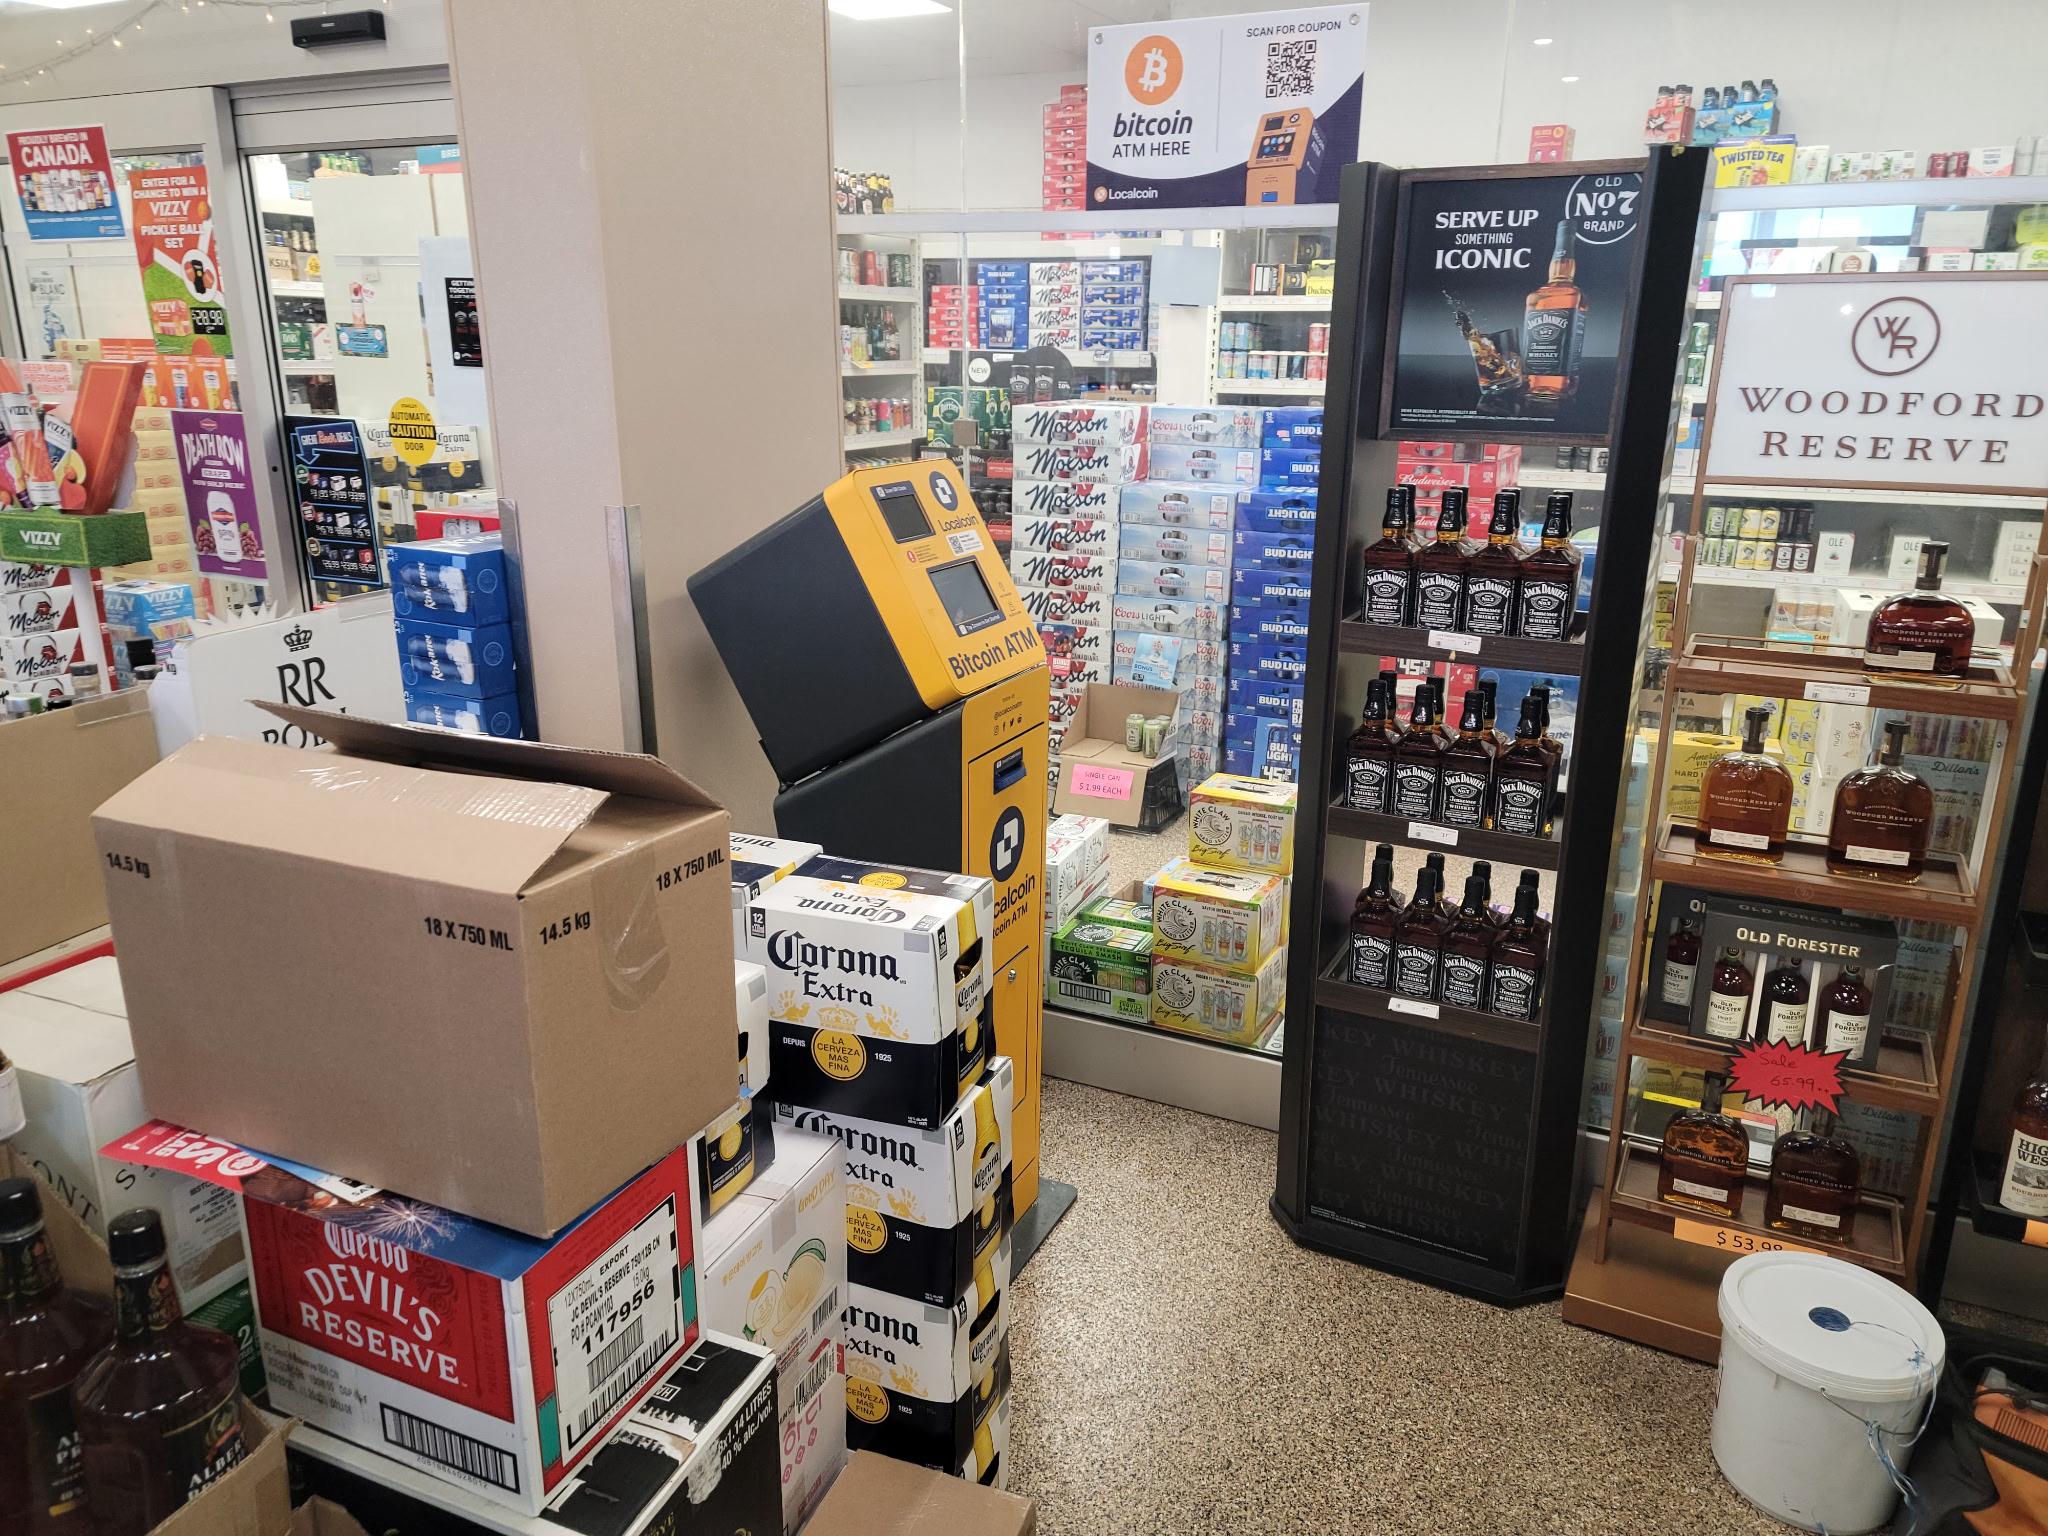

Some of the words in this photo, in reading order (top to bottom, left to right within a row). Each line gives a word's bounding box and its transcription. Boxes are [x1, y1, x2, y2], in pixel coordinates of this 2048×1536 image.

[1246, 27, 1274, 38] SCAN
[1275, 24, 1296, 36] FOR
[1298, 20, 1342, 34] COUPON
[1113, 109, 1193, 138] bitcoin
[21, 144, 93, 167] CANADA
[1112, 142, 1146, 159] ATM
[1150, 141, 1191, 157] HERE
[1720, 150, 1765, 165] TWISTED
[1766, 149, 1786, 164] TEA
[141, 177, 168, 187] ENTER
[170, 176, 187, 186] FOR
[188, 176, 196, 185] A
[1595, 176, 1623, 187] OLD
[133, 189, 168, 199] CHANCE
[169, 188, 179, 197] TO
[1108, 187, 1159, 200] Localcoin
[150, 200, 191, 216] VIZZY
[1435, 210, 1504, 229] SERVE
[1507, 209, 1539, 227] UP
[1583, 220, 1625, 233] BRAND
[141, 225, 176, 236] PICKLE
[1455, 232, 1513, 245] SOMETHING
[164, 237, 184, 248] SET
[1435, 248, 1532, 270] ICONIC
[1307, 286, 1331, 295] Duches
[971, 366, 987, 374] NEW
[1739, 387, 2044, 419] WOODFORD
[391, 412, 431, 423] AUTOMATIC
[1152, 419, 1179, 432] Coors
[1179, 420, 1205, 432] LIGHT
[390, 424, 434, 440] CAUTION
[1025, 410, 1109, 443] Molson
[436, 429, 470, 446] Corona
[181, 434, 215, 474] DEATH
[216, 433, 246, 475] ROW
[404, 441, 424, 452] DOOR
[1760, 431, 2009, 464] RESERVE
[1026, 448, 1109, 480] Molson
[203, 469, 229, 479] GRAPE
[1399, 474, 1456, 486] Budweiser
[1025, 484, 1106, 517] Molson
[937, 513, 980, 533] Localcoin
[20, 530, 62, 546] VIZZY
[1025, 520, 1106, 553] Molson
[1828, 536, 1843, 548] OLE
[418, 562, 437, 610] Kokanee
[1366, 575, 1382, 588] JACK
[1382, 572, 1407, 588] DANIEL'S
[1420, 577, 1435, 588] JACK
[1435, 575, 1460, 591] DANIEL'S
[145, 588, 184, 602] VIZZY
[1264, 586, 1283, 596] BUD
[1284, 587, 1311, 598] LIGH
[1469, 583, 1484, 594] JACK
[1484, 581, 1511, 598] DANIEL'S
[1523, 586, 1540, 599] JACK
[1541, 585, 1568, 602] DANIEL'S
[1115, 607, 1140, 620] Coors
[1141, 613, 1166, 622] LIGHT
[1883, 628, 1926, 638] WOODFORD
[424, 634, 446, 682] Kokanee
[948, 643, 1006, 680] Bitcoin
[1004, 627, 1038, 658] ATM
[1833, 729, 1842, 748] nude
[1675, 769, 1699, 778] HARD
[1931, 761, 1980, 777] Dillon's
[1086, 783, 1101, 793] 1.99
[1102, 785, 1122, 796] EACH
[1709, 793, 1748, 803] WOODFORD
[1749, 799, 1783, 807] RESERVE
[1193, 807, 1206, 829] WHITE
[1208, 805, 1231, 821] CLAW
[1504, 812, 1532, 820] WHISKEY
[106, 852, 135, 873] 14.5
[134, 858, 150, 880] kg
[655, 869, 671, 893] 18
[673, 865, 683, 885] X
[683, 856, 706, 881] 750
[706, 847, 725, 871] ML
[993, 873, 1036, 920] calcoin
[752, 913, 764, 924] 12
[1156, 900, 1170, 922] WHITE
[1171, 900, 1195, 916] CLAW
[424, 916, 444, 937] 18
[445, 920, 457, 940] X
[457, 923, 487, 946] 750
[489, 929, 514, 952] ML
[538, 917, 572, 945] 14.5
[574, 908, 591, 934] kg
[1736, 927, 1770, 944] OLD
[1777, 933, 1862, 958] FORESTER
[767, 929, 900, 982] Corona
[1061, 945, 1093, 956] TEQUILA
[1095, 951, 1121, 961] SMASH
[1155, 969, 1170, 990] WHITE
[1170, 968, 1193, 985] CLAW
[802, 970, 874, 1007] Extra
[1710, 1003, 1742, 1013] FORESTER
[782, 1036, 806, 1047] DEPUIS
[874, 1052, 892, 1062] 1925
[816, 1042, 861, 1056] CERVEZA
[831, 1036, 845, 1045] LA
[828, 1053, 849, 1064] MAS
[828, 1062, 850, 1072] FINA
[1759, 1053, 1798, 1070] Sale
[2019, 1137, 2048, 1156] HIG
[2017, 1149, 2048, 1167] WES
[1717, 1230, 1727, 1246] $
[323, 1221, 410, 1273] Cuervo
[599, 1244, 630, 1276] EXPORT
[571, 1307, 580, 1323] JC
[580, 1283, 603, 1315] DEVIL'S
[603, 1261, 631, 1298] RESERVE
[652, 1234, 661, 1251] CN
[304, 1264, 442, 1343] DEVIL'S
[581, 1279, 655, 1356] 117956
[299, 1301, 461, 1385] RESERVE
[571, 1327, 580, 1345] PO
[744, 1381, 772, 1424] LITRES
[721, 1454, 733, 1472] 40
[733, 1441, 742, 1457] %
[743, 1404, 773, 1444] alc./vol.
